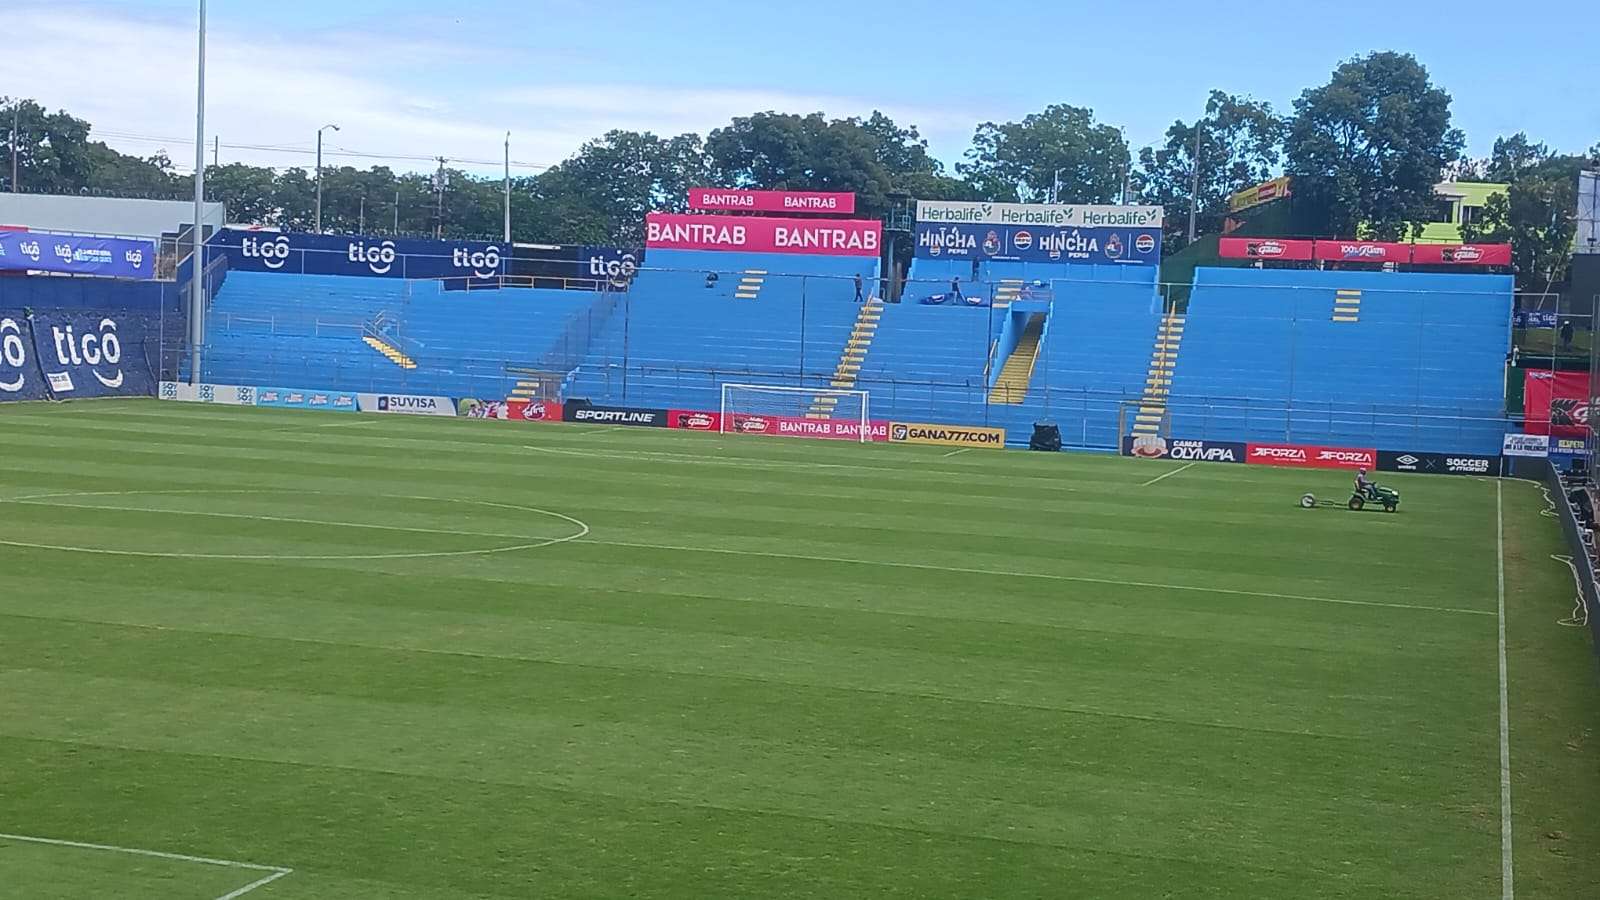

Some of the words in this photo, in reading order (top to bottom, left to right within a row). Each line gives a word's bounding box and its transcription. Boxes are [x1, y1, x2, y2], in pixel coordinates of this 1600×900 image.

[703, 194, 753, 206] BANTRAB
[784, 197, 836, 209] BANTRAB
[922, 206, 983, 221] Herbalife
[1001, 208, 1064, 223] Herbalife
[1083, 209, 1147, 225] Herbalife
[647, 222, 746, 245] BANTRAB
[775, 227, 878, 250] BANTRAB
[919, 228, 977, 248] HINCHA
[1039, 230, 1099, 252] HINCHA
[390, 396, 437, 409] SUVISA
[575, 410, 655, 423] SPORTLINE
[780, 422, 831, 434] BANTRAB
[909, 428, 1000, 443] GANA777.COM
[1170, 447, 1236, 461] OLYMPIA
[1446, 457, 1489, 468] SOCCER
